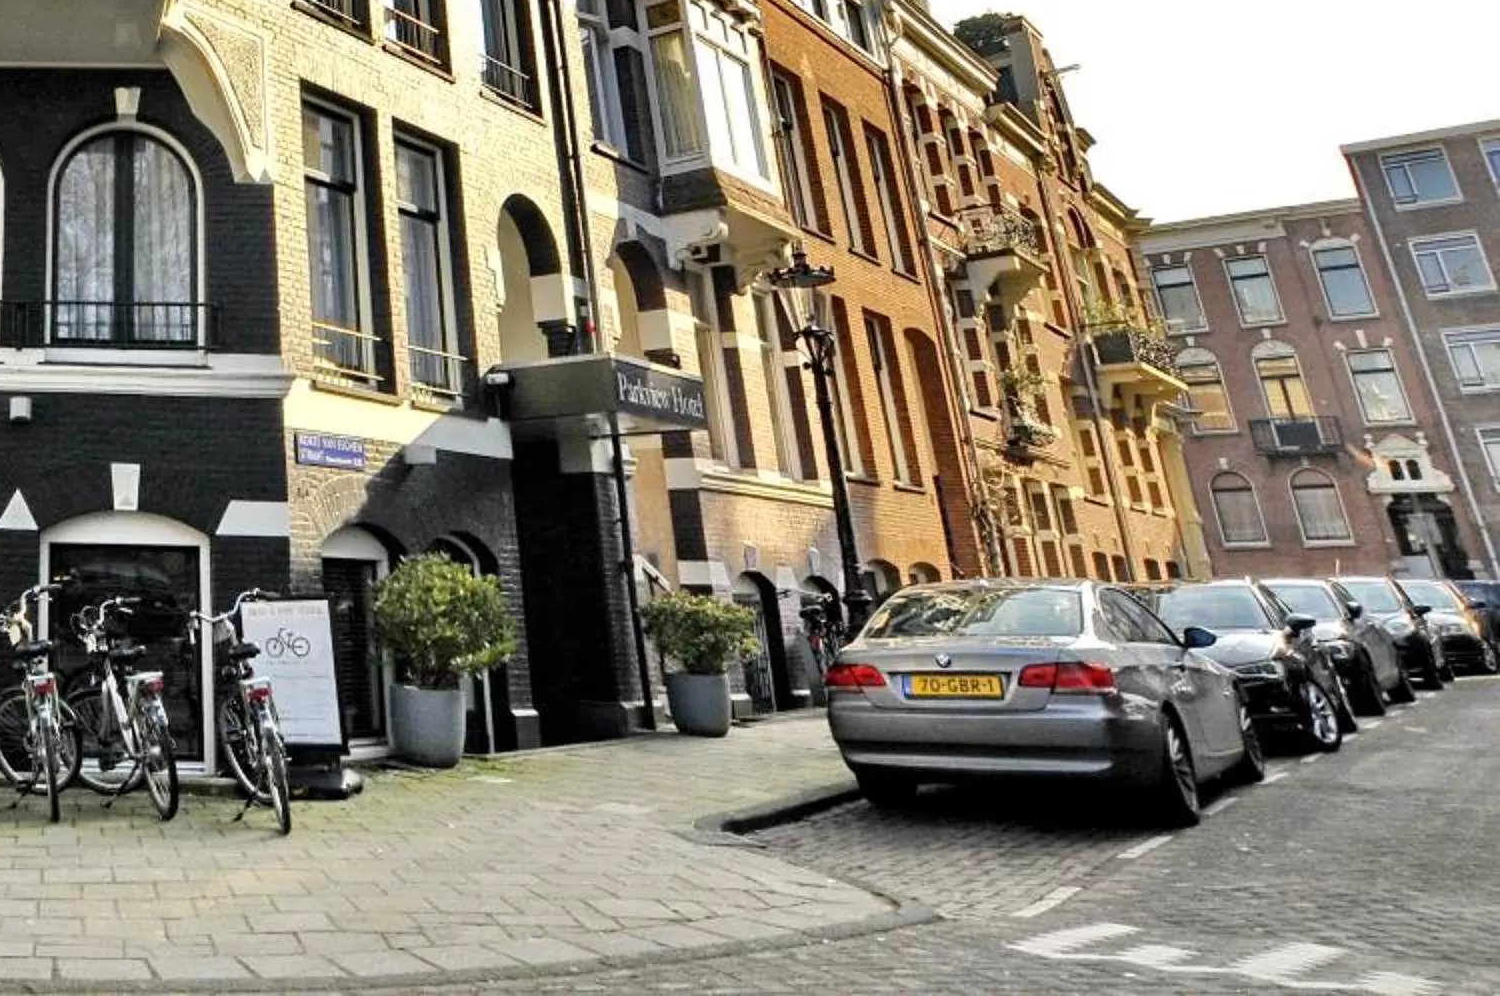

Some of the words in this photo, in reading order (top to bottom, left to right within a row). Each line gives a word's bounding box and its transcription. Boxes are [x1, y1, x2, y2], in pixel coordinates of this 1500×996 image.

[617, 371, 670, 410] Parkview
[672, 385, 705, 420] Hotel
[919, 678, 995, 693] 70-GBR-1
